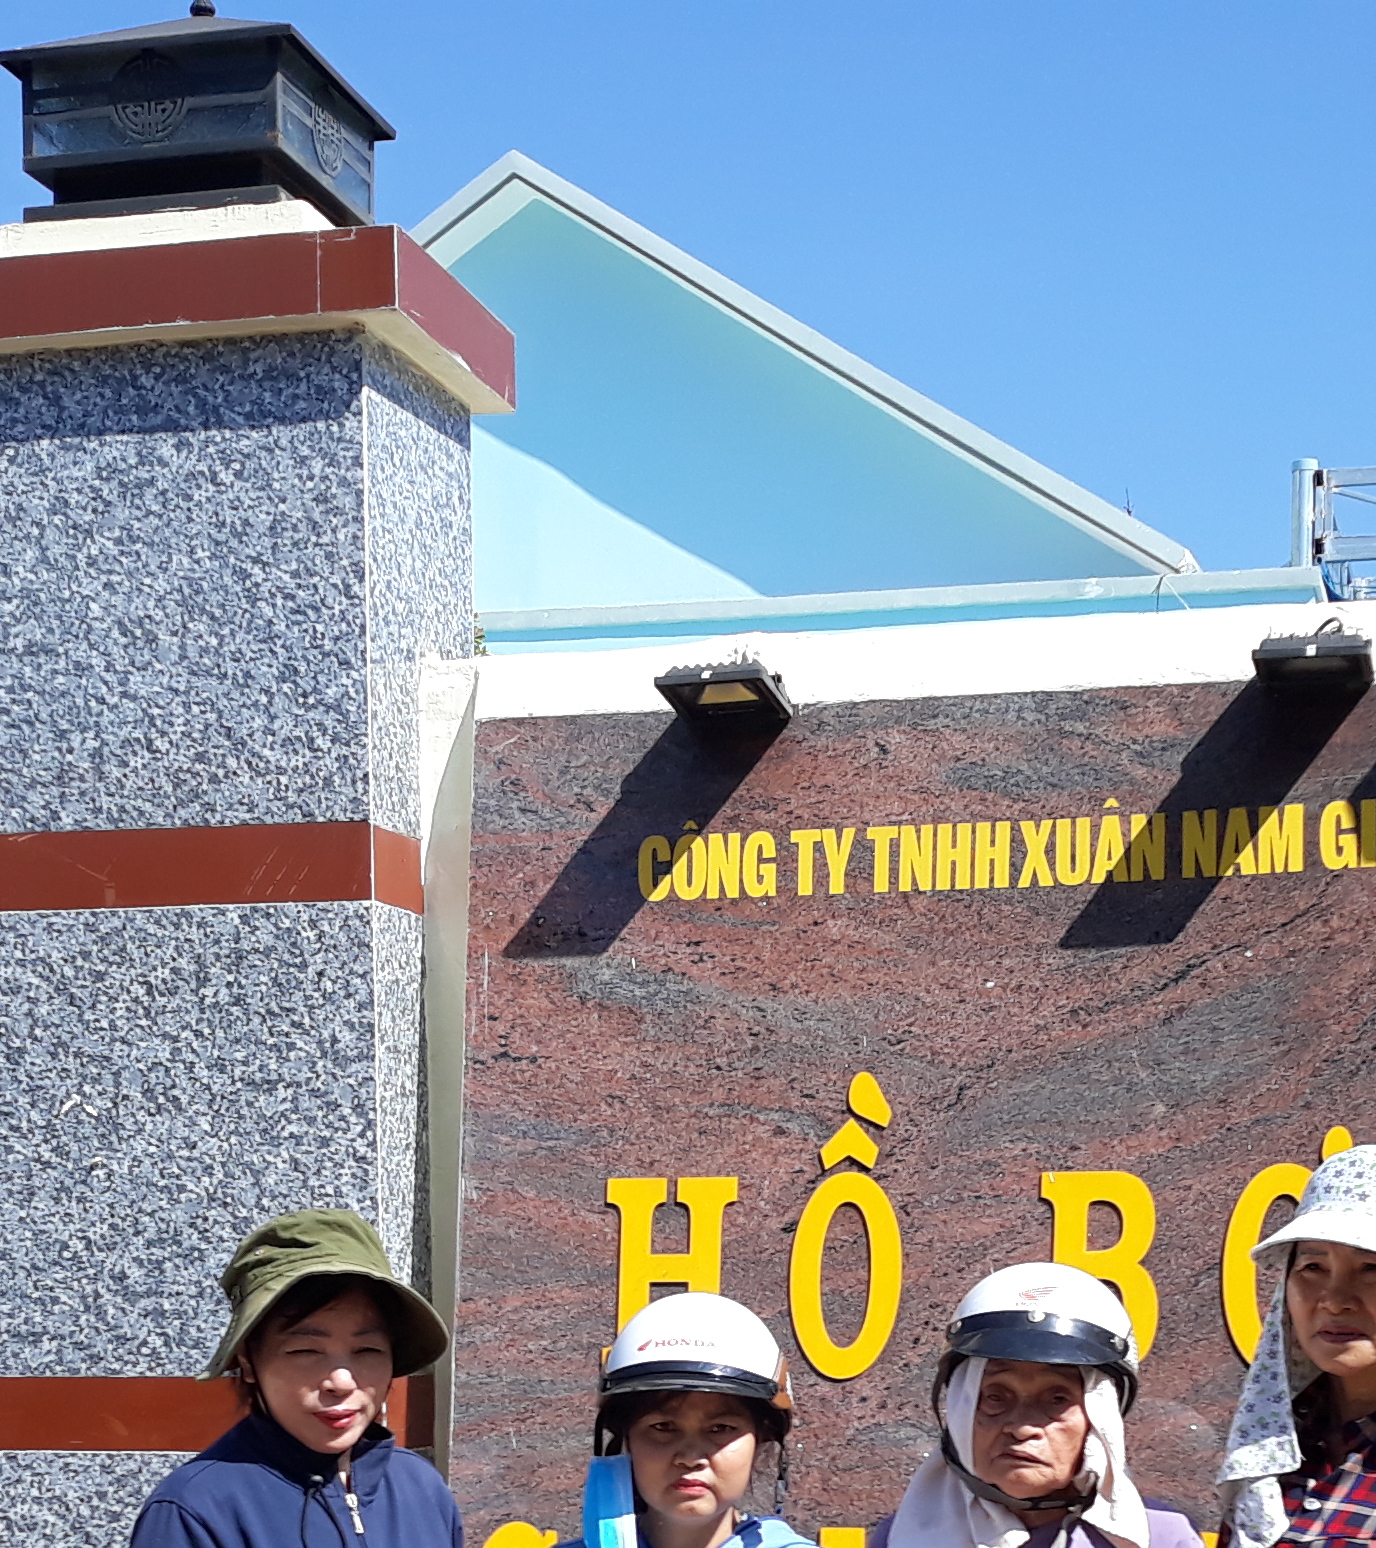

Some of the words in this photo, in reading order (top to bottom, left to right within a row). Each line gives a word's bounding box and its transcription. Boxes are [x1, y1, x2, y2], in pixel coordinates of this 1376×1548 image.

[638, 820, 777, 901] CÔNG
[790, 828, 856, 896] TY
[867, 821, 1011, 893] TNHH
[1018, 797, 1166, 888] XUÂN
[1181, 803, 1306, 878] NAM
[601, 1071, 903, 1379] HỒ
[654, 1338, 716, 1348] HONDA
